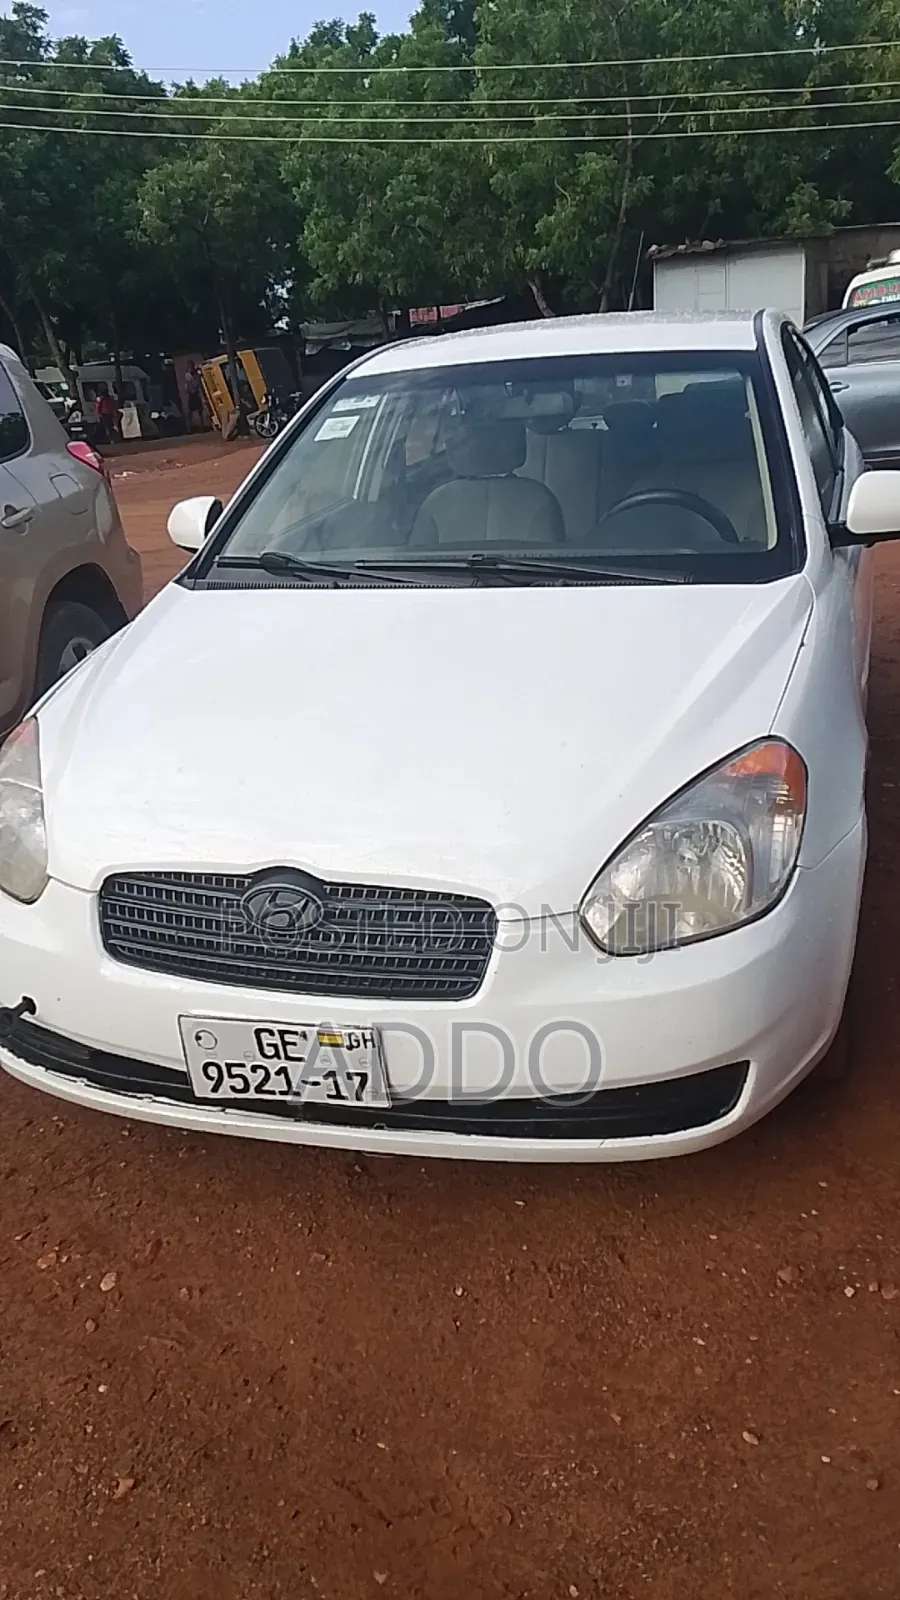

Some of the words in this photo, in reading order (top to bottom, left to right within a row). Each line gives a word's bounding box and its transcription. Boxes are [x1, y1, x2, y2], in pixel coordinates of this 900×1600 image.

[254, 1027, 306, 1062] GE
[346, 1031, 376, 1050] GH
[202, 1061, 369, 1101] 9521-17
